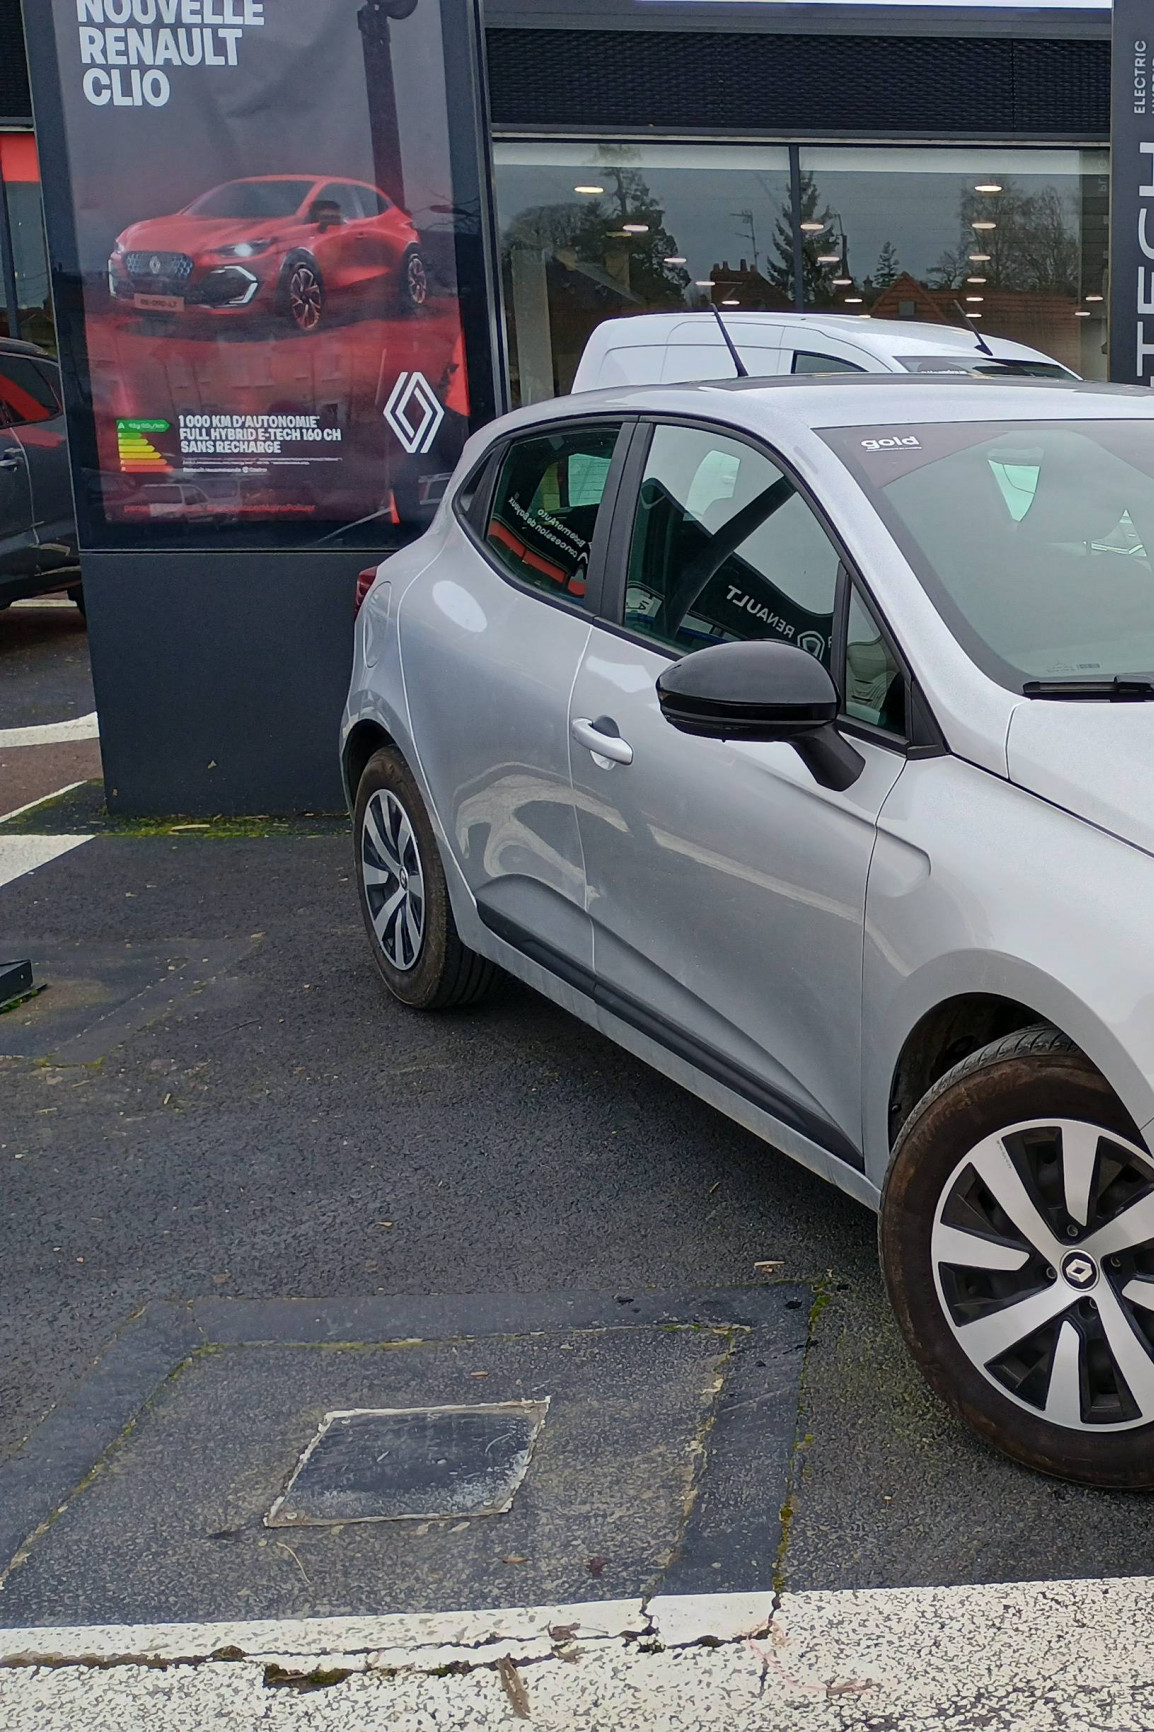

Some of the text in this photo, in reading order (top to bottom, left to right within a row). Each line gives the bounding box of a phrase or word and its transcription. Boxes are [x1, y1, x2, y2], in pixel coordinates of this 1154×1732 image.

[76, 0, 265, 26] NOUVELLE
[79, 26, 243, 66] RENAULT
[83, 67, 170, 107] CLIO
[1134, 41, 1146, 113] ELECTRIC
[212, 415, 232, 428] KM
[179, 428, 342, 441] FULL HYBRID E-TECH 160 CH
[861, 436, 920, 450] gold
[180, 440, 282, 454] SANS RECHARGE
